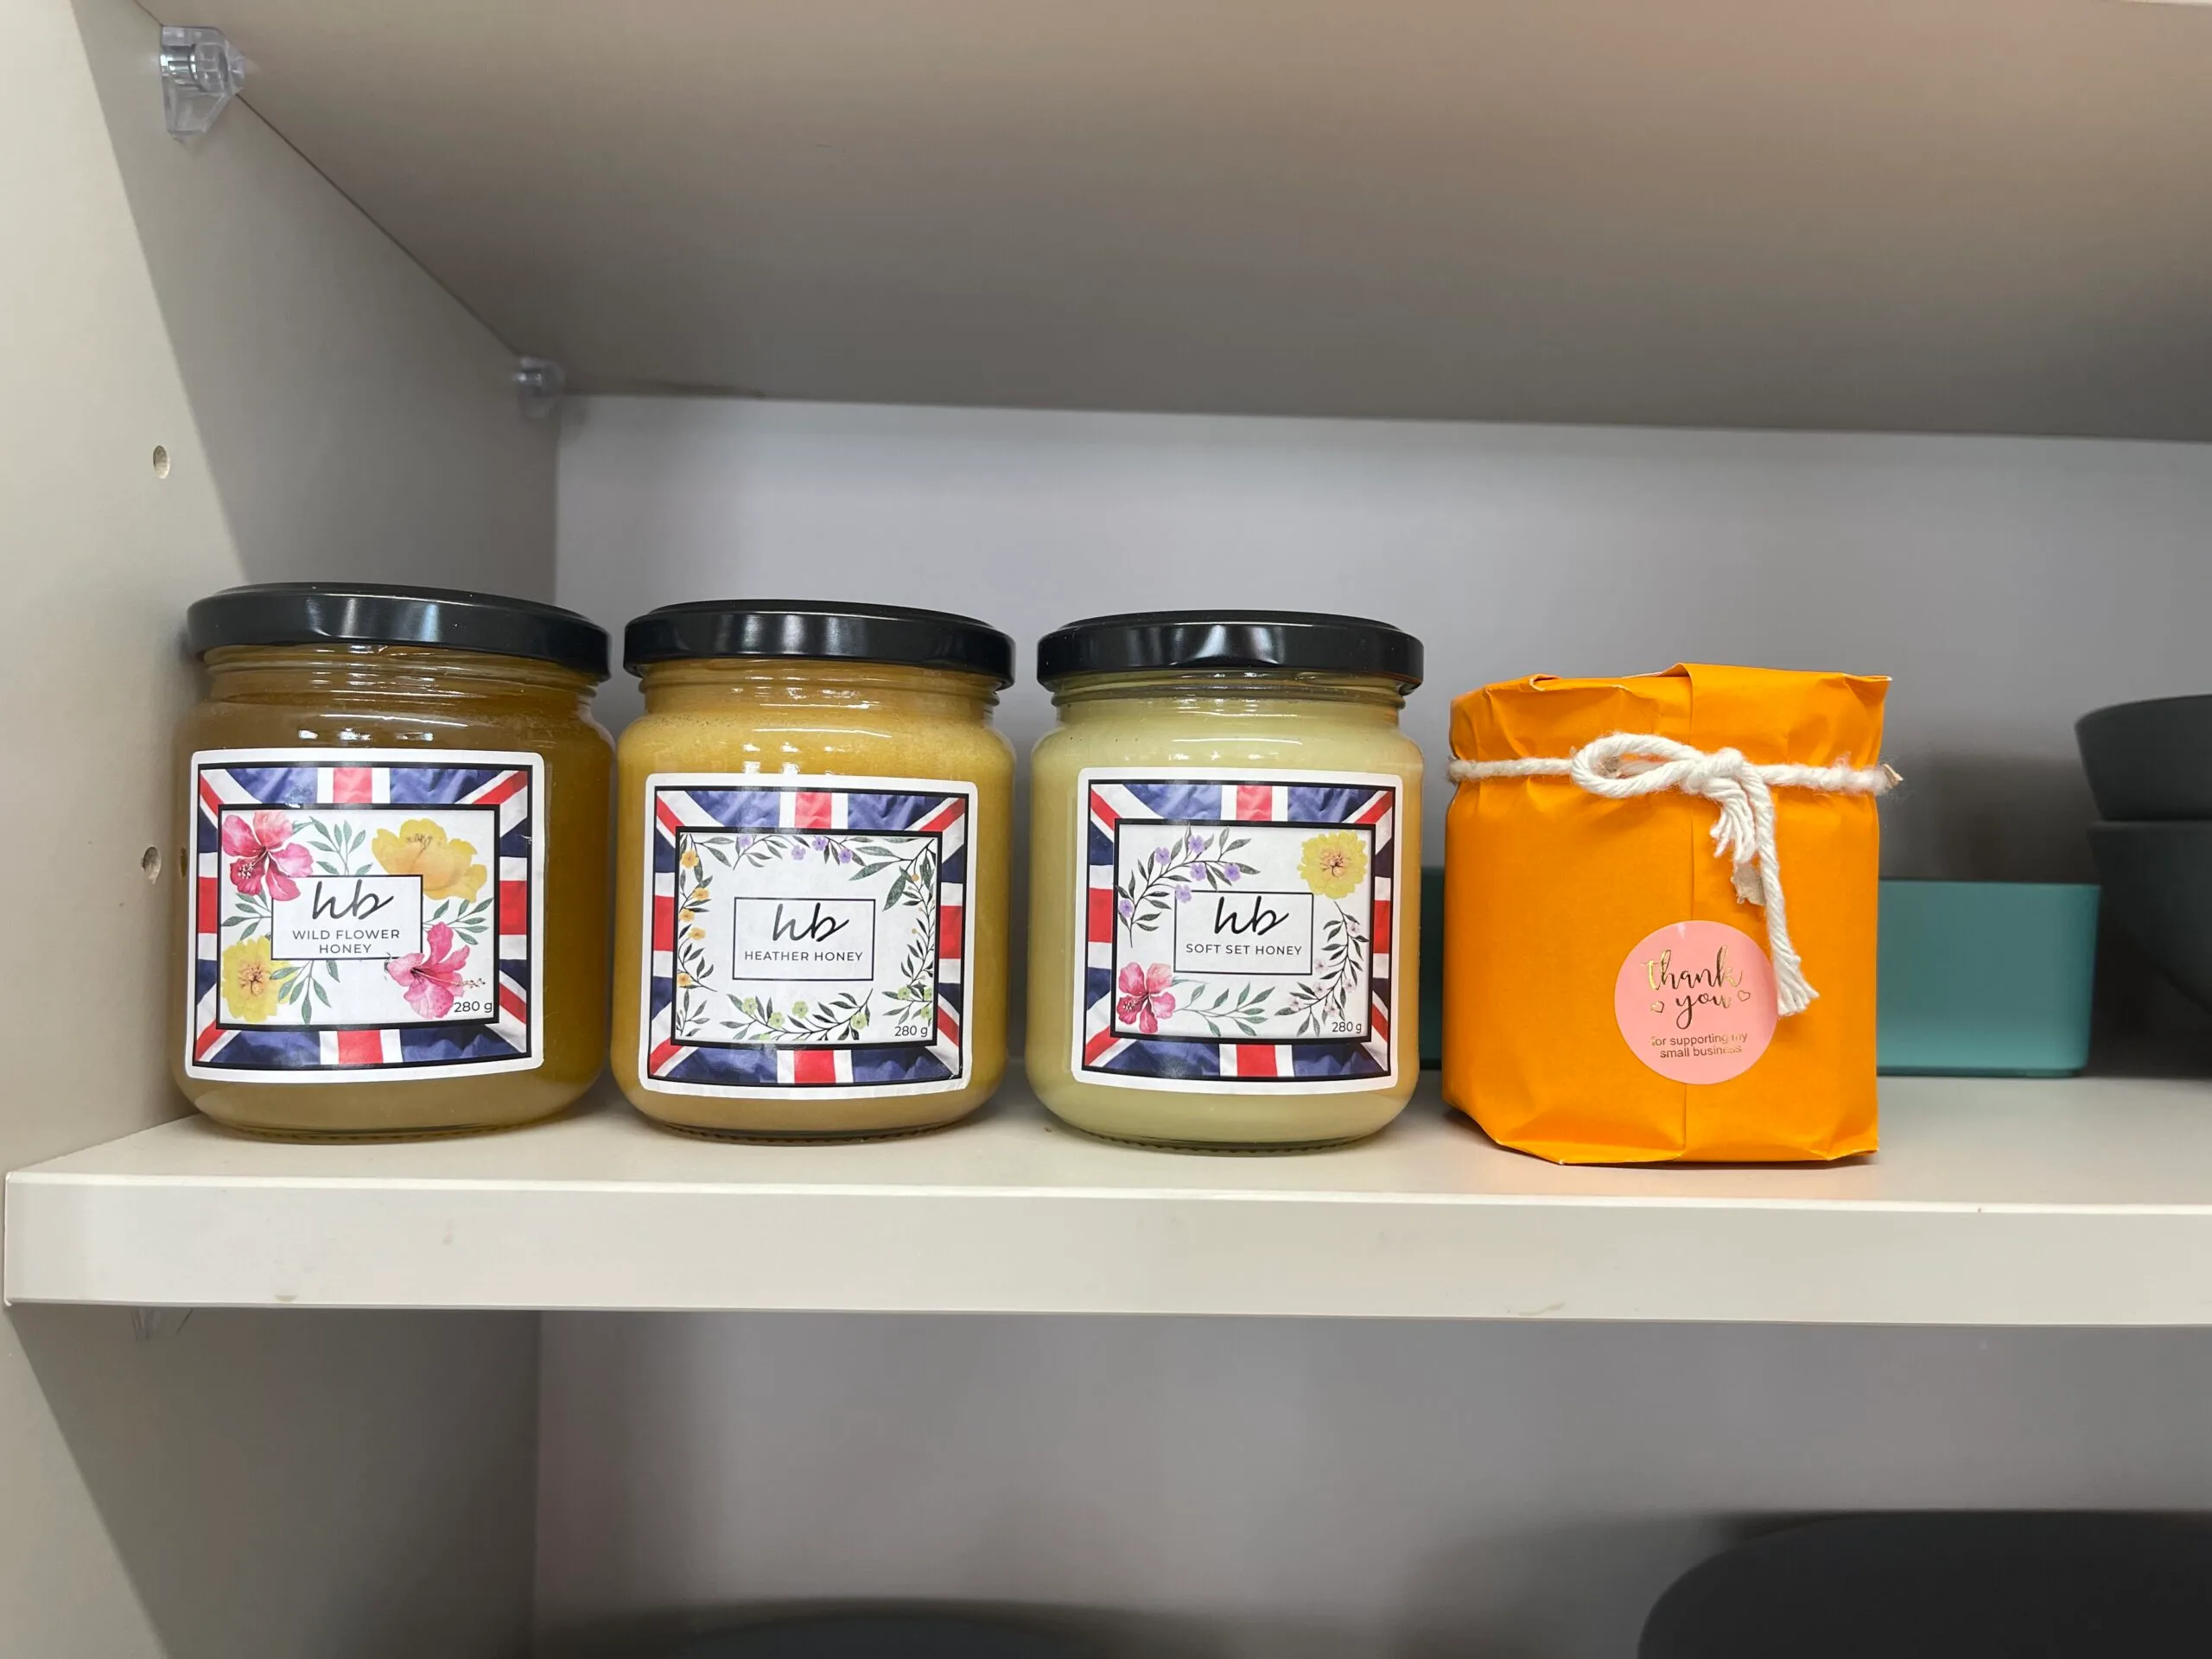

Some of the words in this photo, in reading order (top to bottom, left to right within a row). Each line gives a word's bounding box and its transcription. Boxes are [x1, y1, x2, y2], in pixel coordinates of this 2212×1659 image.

[310, 878, 395, 921] hb
[1213, 895, 1290, 936] hb
[772, 902, 850, 943] hb
[292, 929, 330, 940] WILD
[335, 928, 400, 941] FLOWER
[319, 944, 372, 955] HONEY
[1185, 943, 1221, 954] SOFT
[1225, 944, 1251, 955] SET
[1255, 944, 1302, 956] HONEY
[744, 950, 809, 963] HEATHER
[814, 951, 863, 963] HONEY
[454, 1001, 480, 1014] 280
[483, 1002, 493, 1014] g
[1675, 993, 1732, 1030] you
[894, 1025, 918, 1038] 280
[920, 1027, 928, 1038] g
[1332, 1021, 1353, 1033] 280
[1355, 1023, 1363, 1034] g
[1669, 1033, 1730, 1046] supporting
[1660, 1047, 1690, 1058] small
[1693, 1045, 1742, 1056] business
